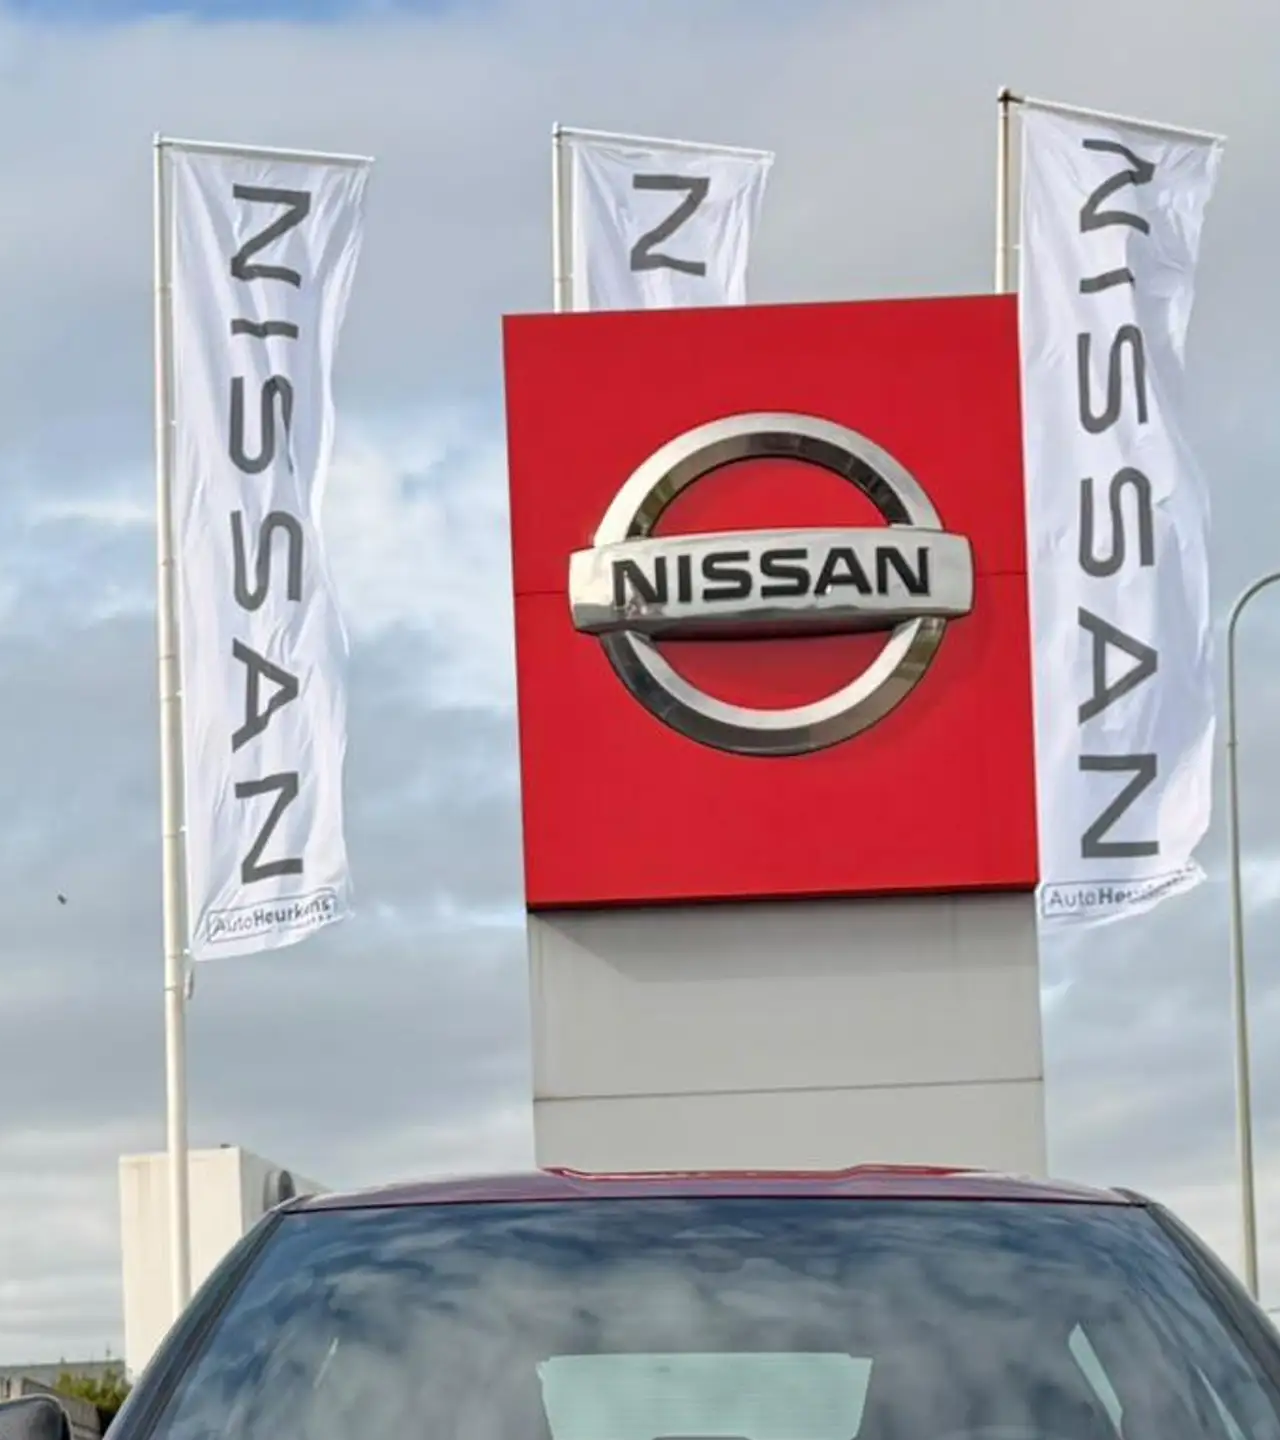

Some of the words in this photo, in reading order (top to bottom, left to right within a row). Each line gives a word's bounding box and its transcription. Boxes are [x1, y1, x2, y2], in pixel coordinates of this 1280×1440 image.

[229, 183, 311, 883] NISSAN
[611, 546, 931, 606] NISSAN
[1078, 139, 1160, 861] NISSAN
